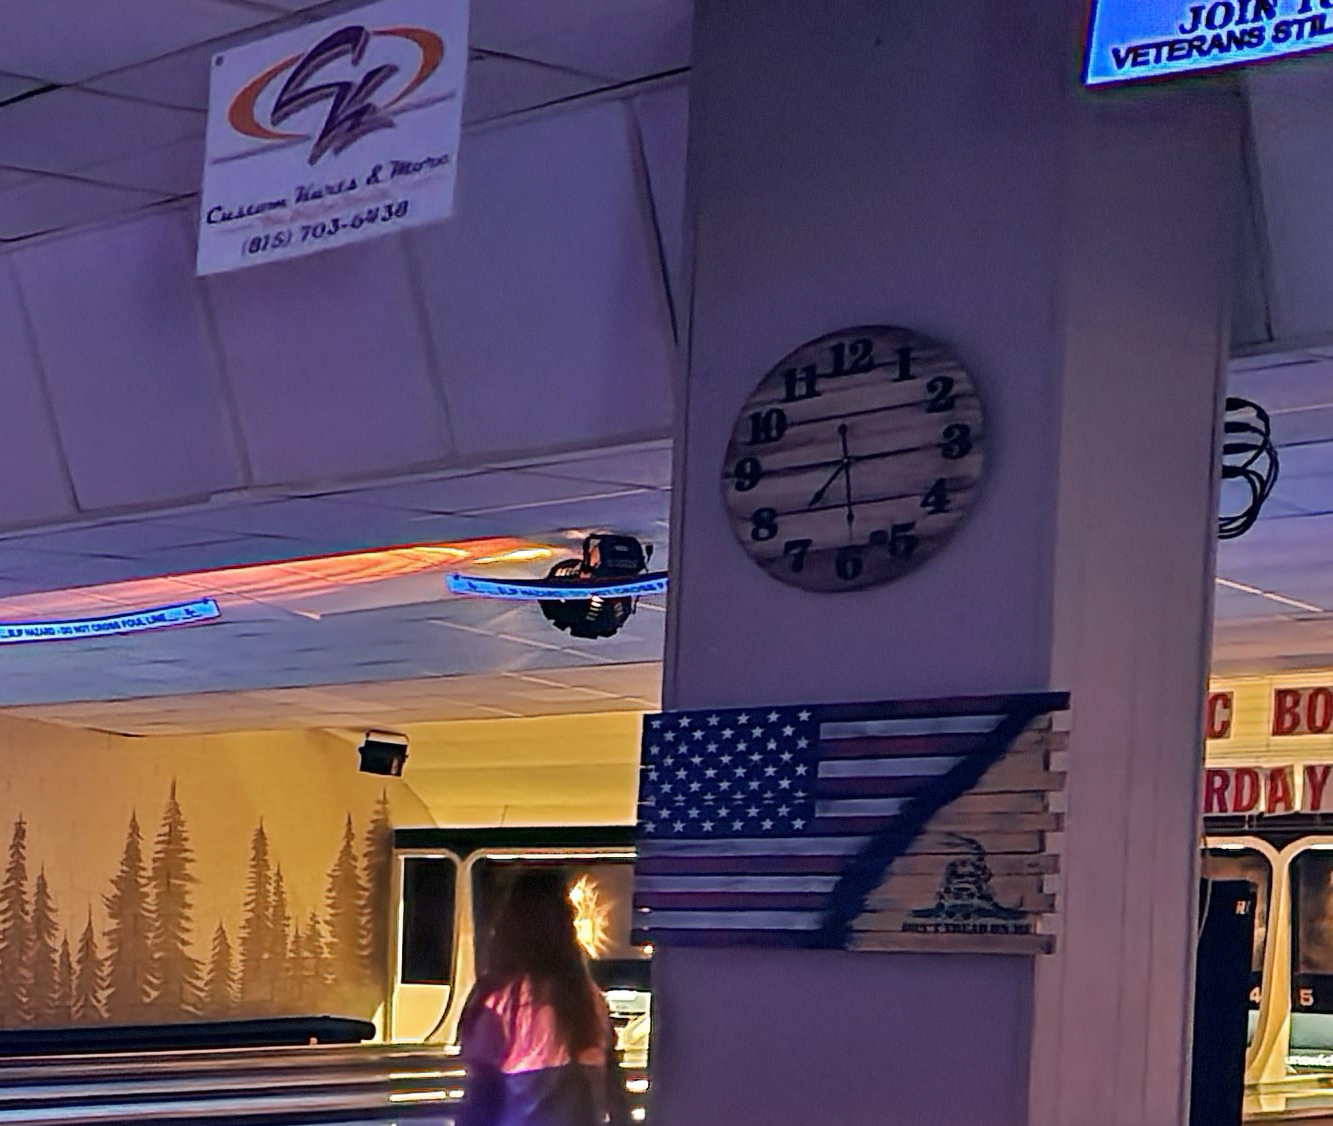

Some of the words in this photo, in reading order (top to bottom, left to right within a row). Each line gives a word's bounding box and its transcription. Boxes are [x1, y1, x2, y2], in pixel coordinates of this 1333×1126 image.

[1111, 26, 1266, 69] VETERANS
[206, 198, 287, 224] Custom
[366, 164, 382, 185] &
[390, 154, 449, 179] More
[241, 230, 293, 256] (815)
[830, 338, 875, 376] 12
[892, 346, 916, 382] 1
[782, 364, 822, 402] 11
[925, 376, 956, 413] 2
[741, 408, 788, 446] 10
[941, 423, 972, 459] 3
[734, 457, 762, 492] 9
[920, 478, 951, 515] 4
[751, 507, 778, 541] 8
[889, 521, 918, 558] 5
[784, 539, 812, 573] 7
[835, 544, 863, 580] 6
[1299, 987, 1314, 1007] 5
